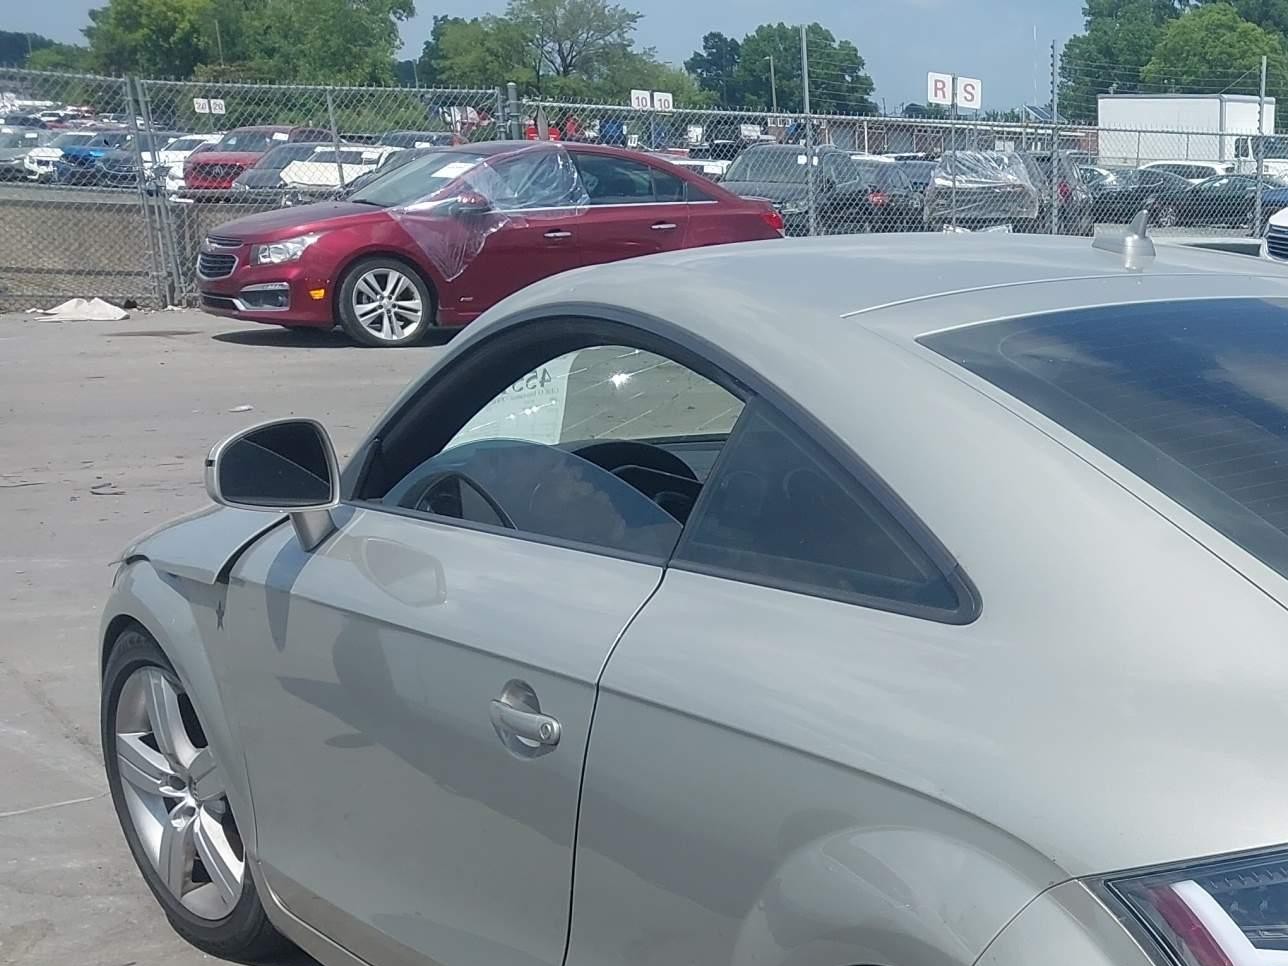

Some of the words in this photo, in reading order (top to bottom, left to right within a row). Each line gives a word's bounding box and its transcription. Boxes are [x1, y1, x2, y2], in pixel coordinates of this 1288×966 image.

[933, 79, 947, 99] R
[963, 83, 976, 102] S
[635, 95, 648, 108] 10
[657, 98, 670, 110] 10
